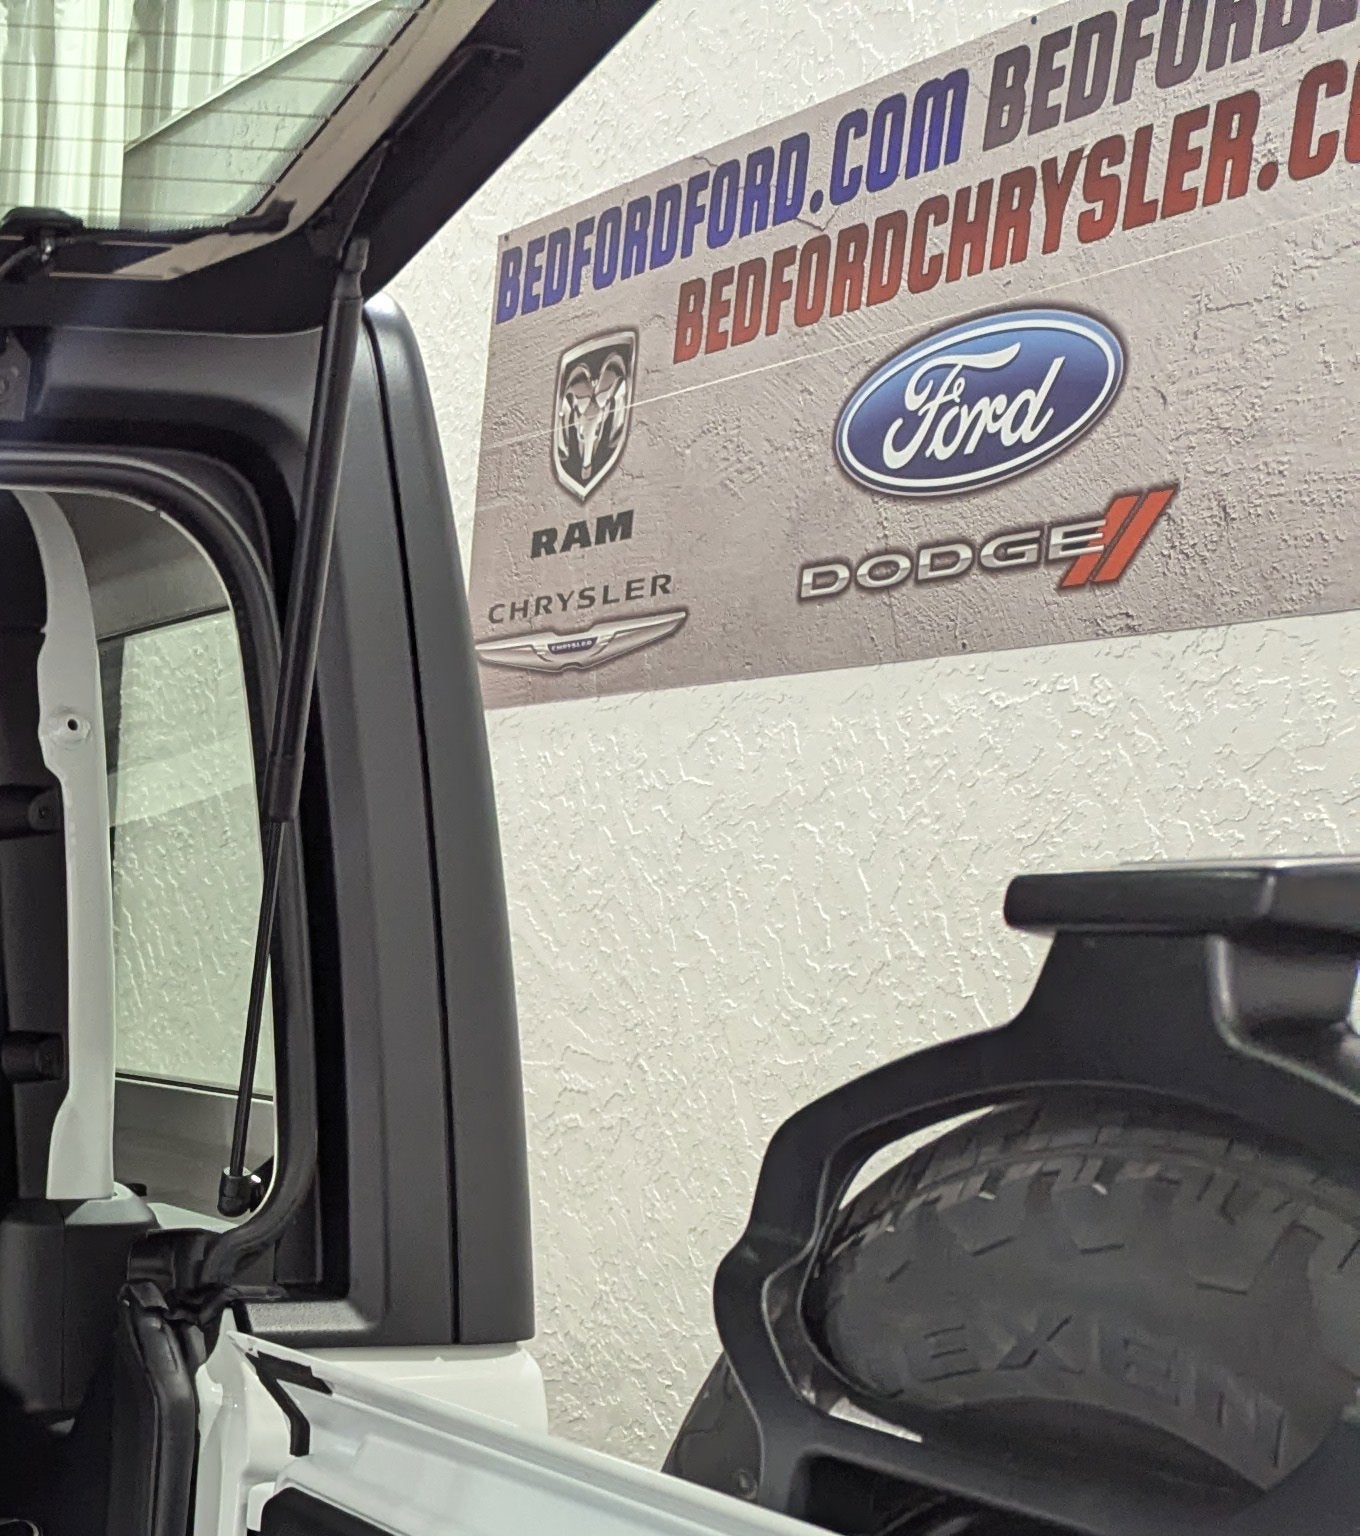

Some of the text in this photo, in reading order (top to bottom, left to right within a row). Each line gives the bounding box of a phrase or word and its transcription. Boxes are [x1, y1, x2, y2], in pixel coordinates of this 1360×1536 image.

[495, 68, 970, 325] BEDFORDFORD.COM
[673, 59, 1360, 364] BEDFORDCHRYSLER.C
[882, 341, 1066, 470] Ford
[530, 509, 635, 559] RAM
[799, 519, 1107, 599] DODGE
[488, 574, 672, 624] CHRYSLER
